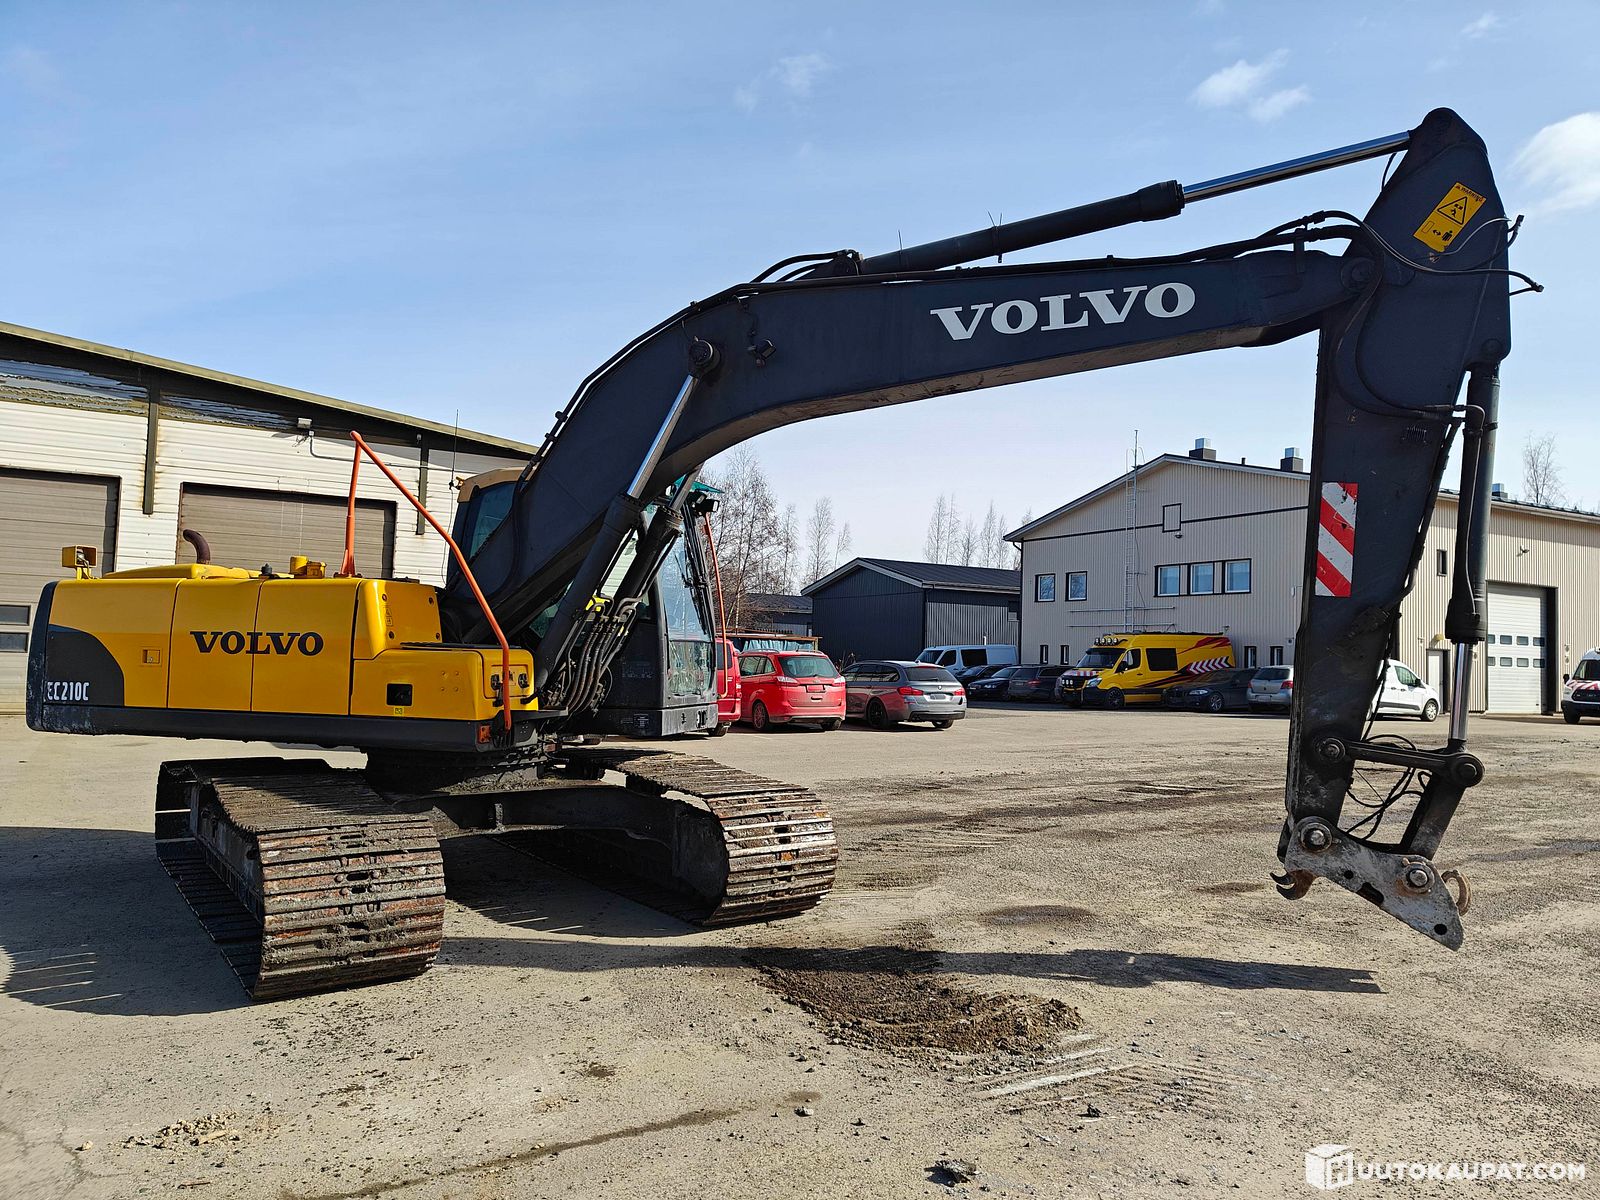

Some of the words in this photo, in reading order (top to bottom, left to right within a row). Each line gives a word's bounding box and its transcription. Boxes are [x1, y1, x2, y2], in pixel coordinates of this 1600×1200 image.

[930, 282, 1196, 341] VOLVO
[190, 631, 322, 656] VOLVO
[46, 681, 90, 701] EC210C
